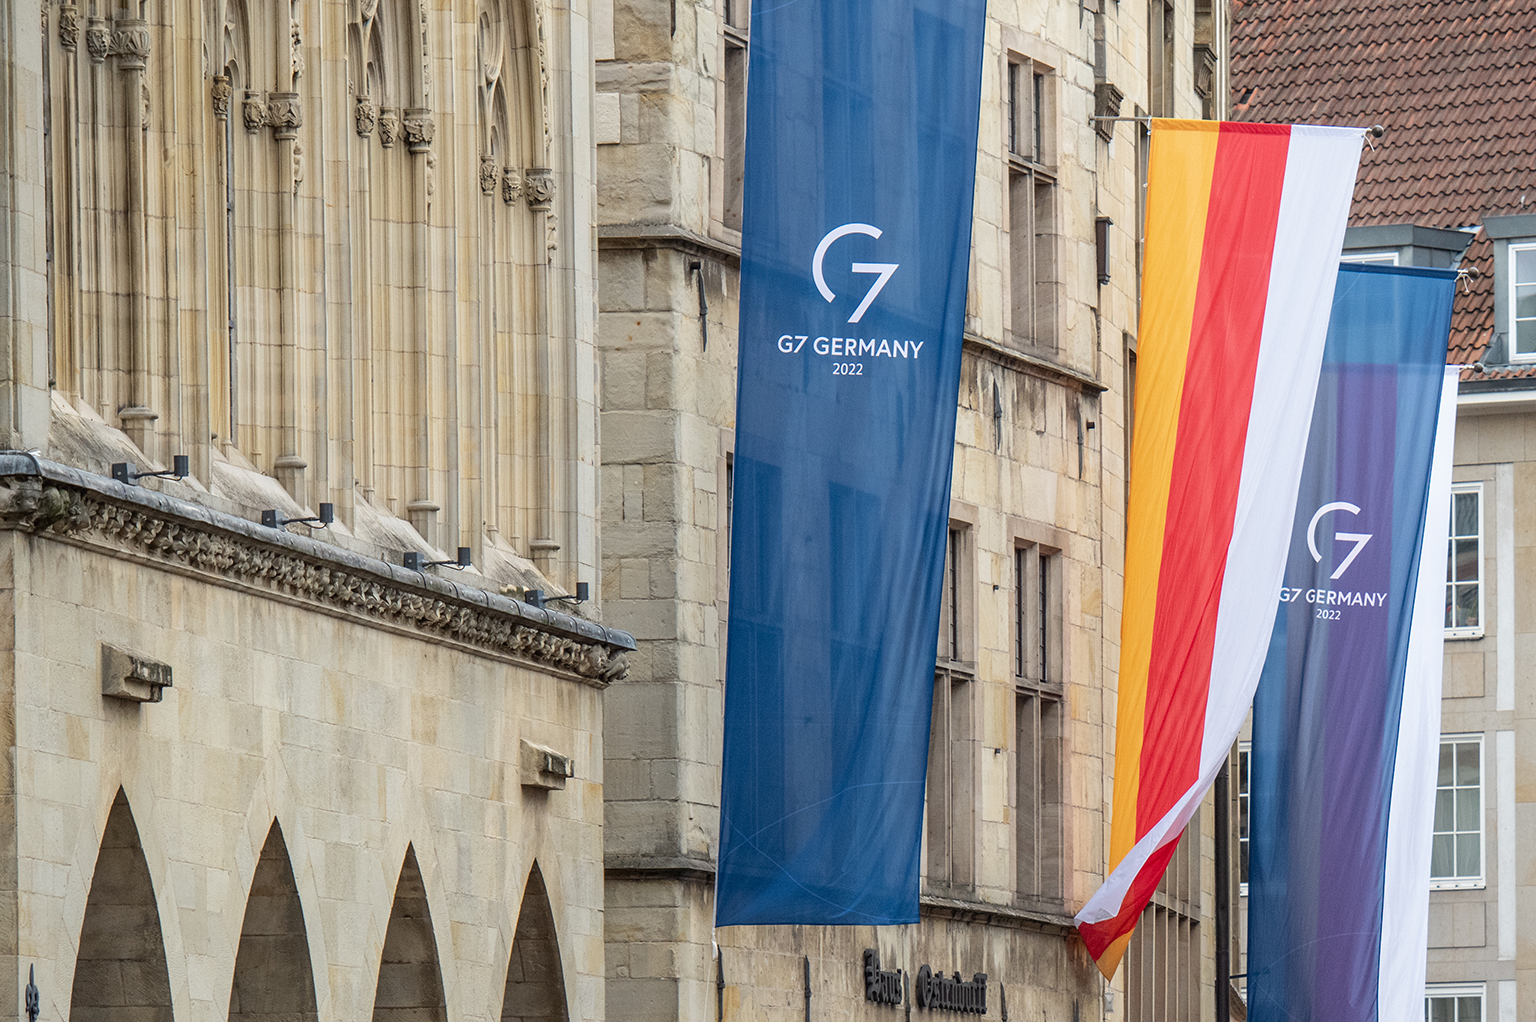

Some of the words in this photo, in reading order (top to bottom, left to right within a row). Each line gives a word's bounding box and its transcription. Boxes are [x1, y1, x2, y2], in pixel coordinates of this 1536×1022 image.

[812, 222, 899, 323] G7
[777, 334, 808, 354] G7
[813, 336, 924, 359] GERMANY
[832, 362, 863, 376] 2022
[1307, 501, 1373, 580] G7
[1279, 587, 1302, 602] G7
[1305, 588, 1387, 607] GERMANY
[1316, 608, 1341, 620] 2022
